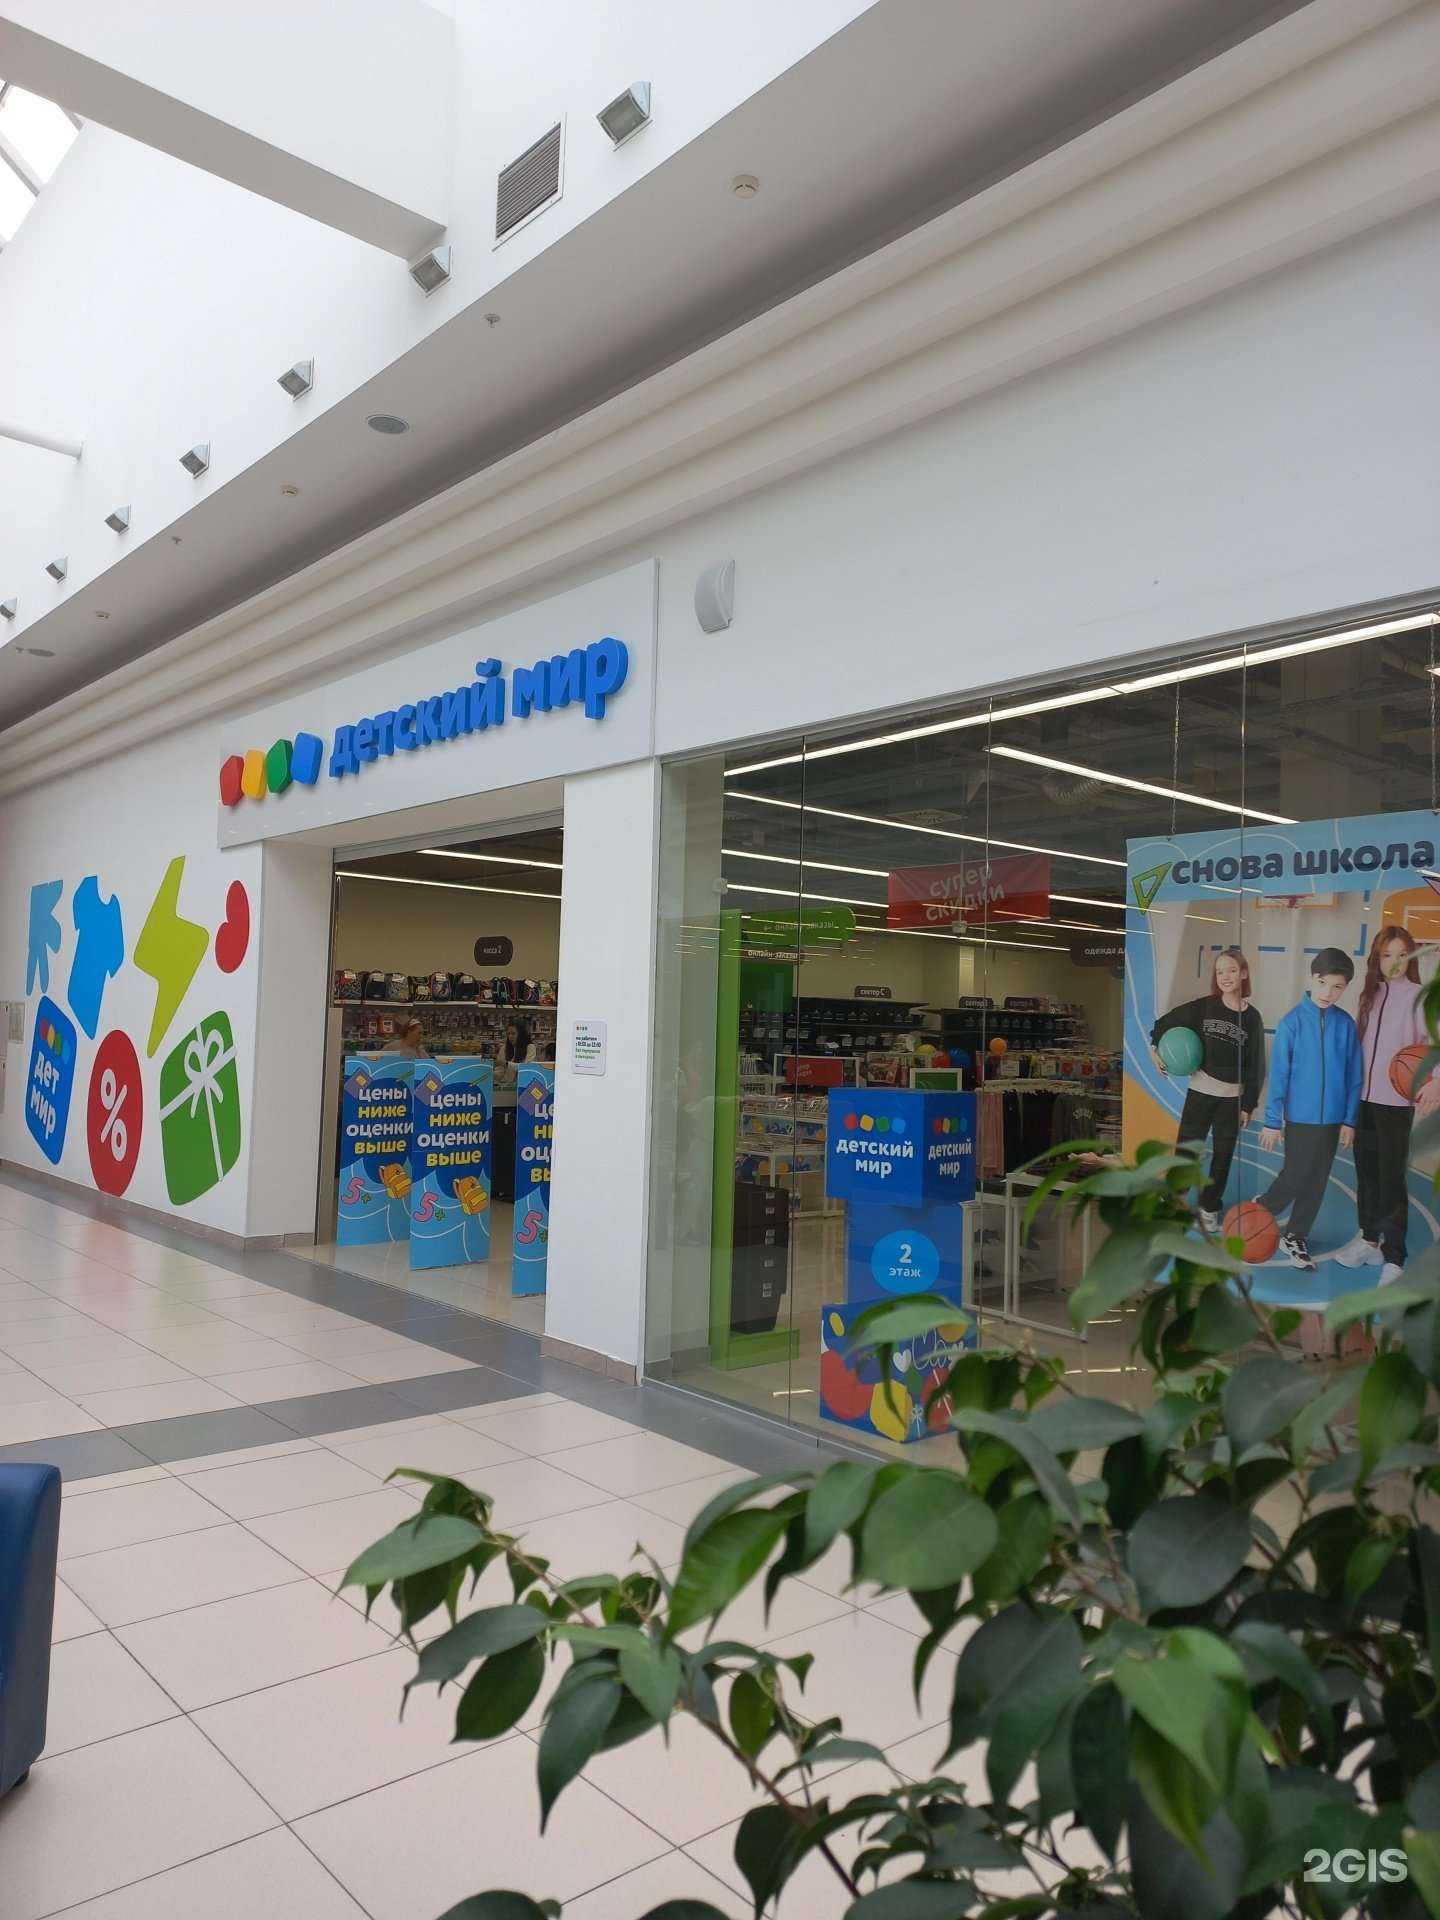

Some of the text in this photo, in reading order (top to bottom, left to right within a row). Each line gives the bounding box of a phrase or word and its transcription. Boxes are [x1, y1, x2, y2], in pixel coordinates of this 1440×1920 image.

[329, 636, 629, 778] детский мир
[1172, 840, 1435, 885] снова школа
[34, 1051, 60, 1095] дет
[358, 1087, 407, 1102] цены
[430, 1093, 482, 1108] цены
[31, 1084, 56, 1140] мир
[358, 1105, 407, 1119] ниже
[429, 1112, 482, 1128] ниже
[346, 1121, 414, 1138] оценки
[354, 1140, 407, 1155] выше
[417, 1130, 490, 1149] оценки
[836, 1138, 914, 1159] детский
[426, 1150, 482, 1167] выше
[928, 1138, 972, 1161] детский
[855, 1158, 893, 1179] мир
[939, 1160, 961, 1179] мир
[899, 1243, 912, 1264] 2
[888, 1266, 921, 1278] этаж
